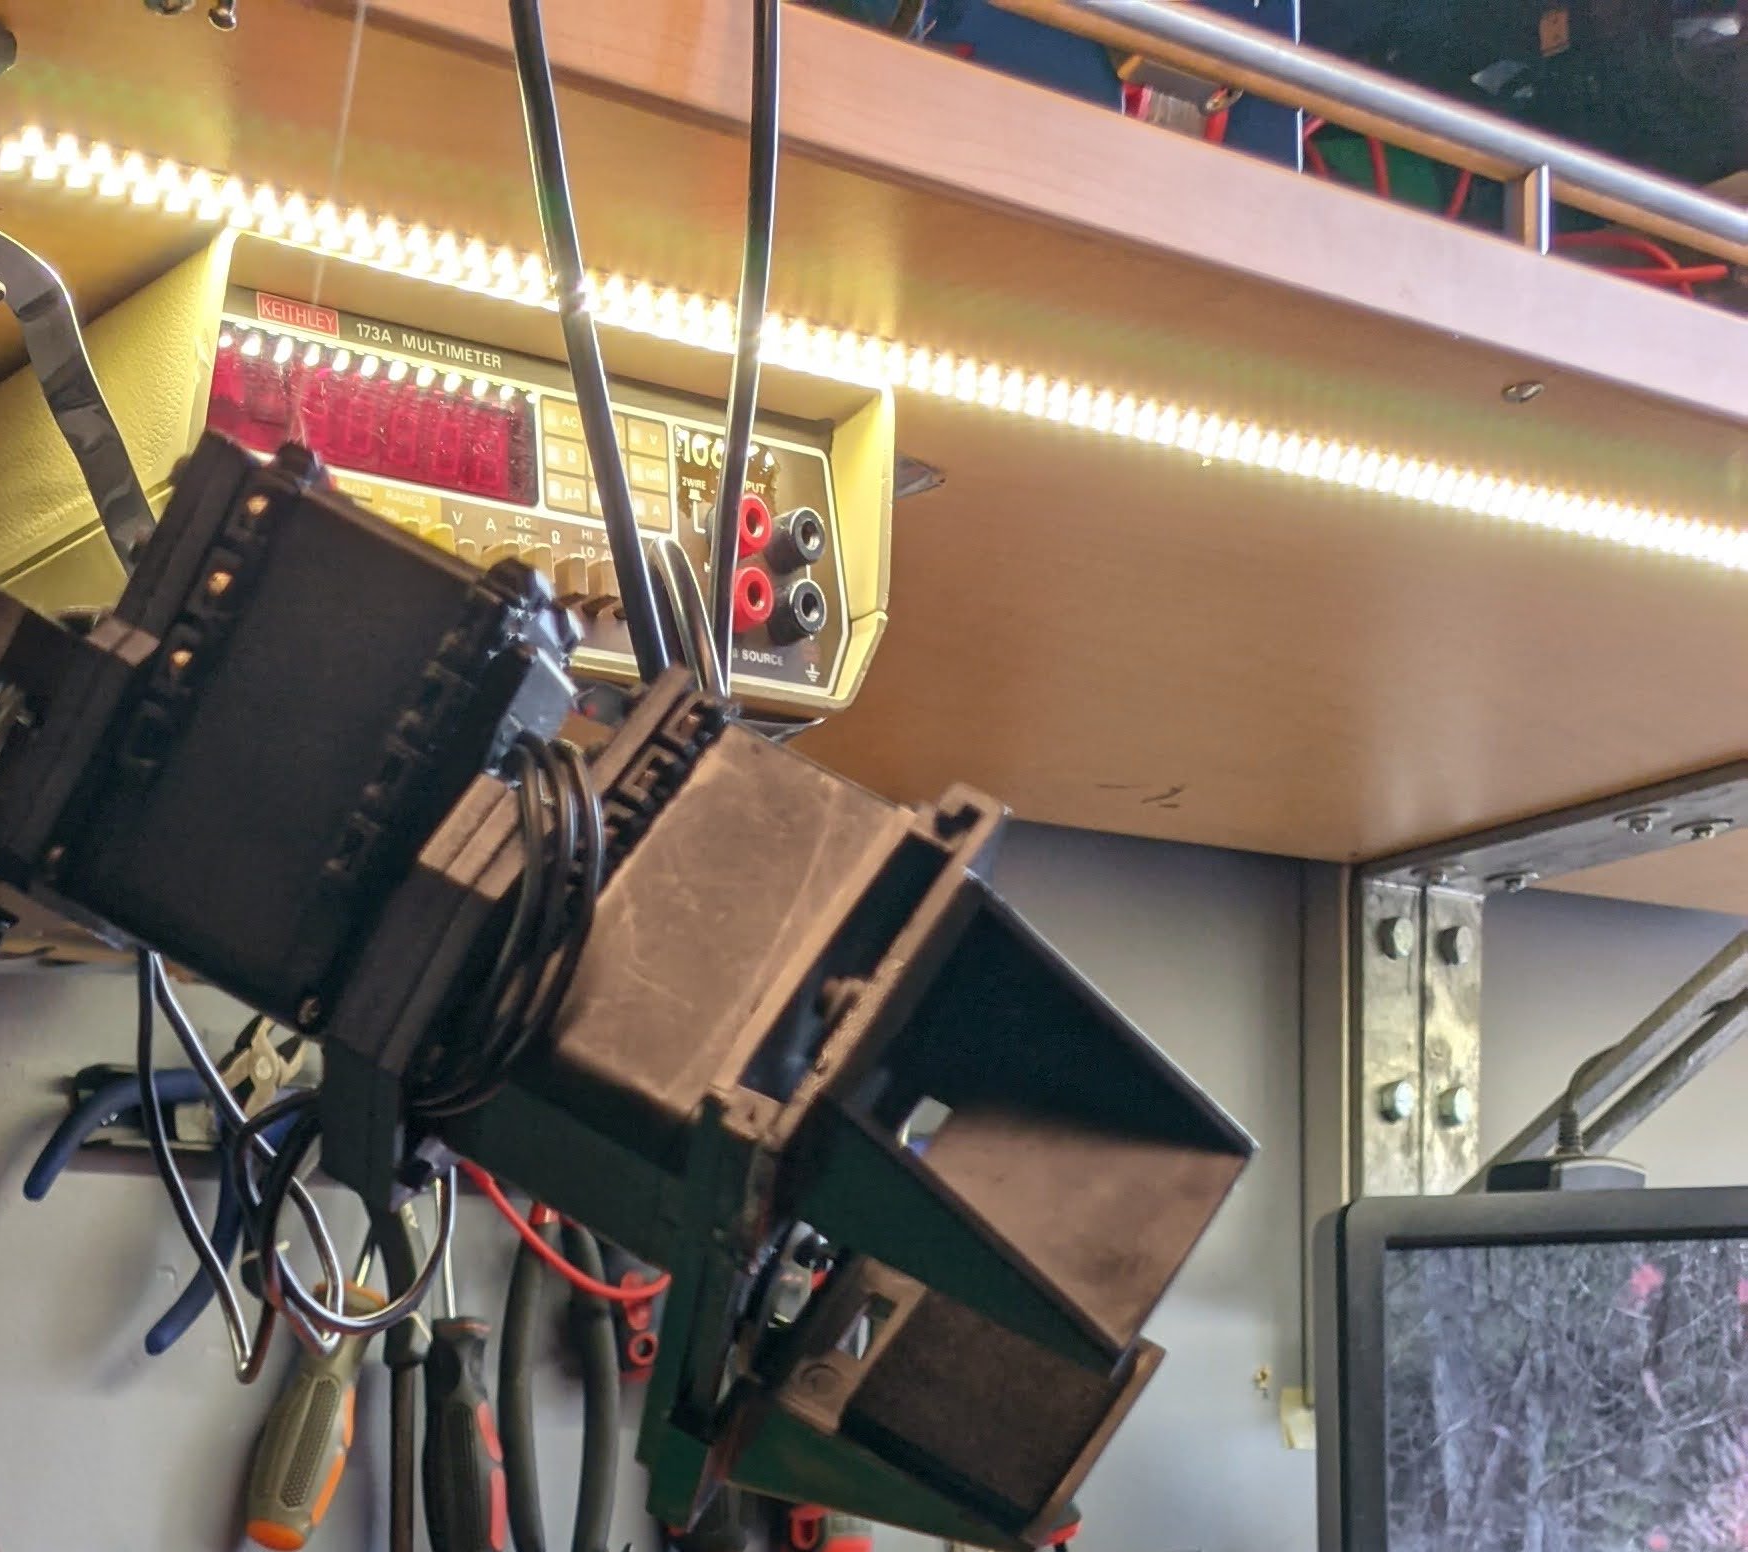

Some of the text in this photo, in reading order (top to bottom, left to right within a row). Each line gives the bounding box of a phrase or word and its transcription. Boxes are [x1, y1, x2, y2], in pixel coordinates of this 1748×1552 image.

[260, 299, 336, 331] KEITHLEY
[356, 322, 502, 369] 173A MULTIMETER
[681, 476, 767, 494] 2WIRE PUT
[452, 510, 464, 526] V
[484, 517, 498, 533] A
[515, 515, 532, 530] DC
[741, 647, 784, 667] SOURCE
